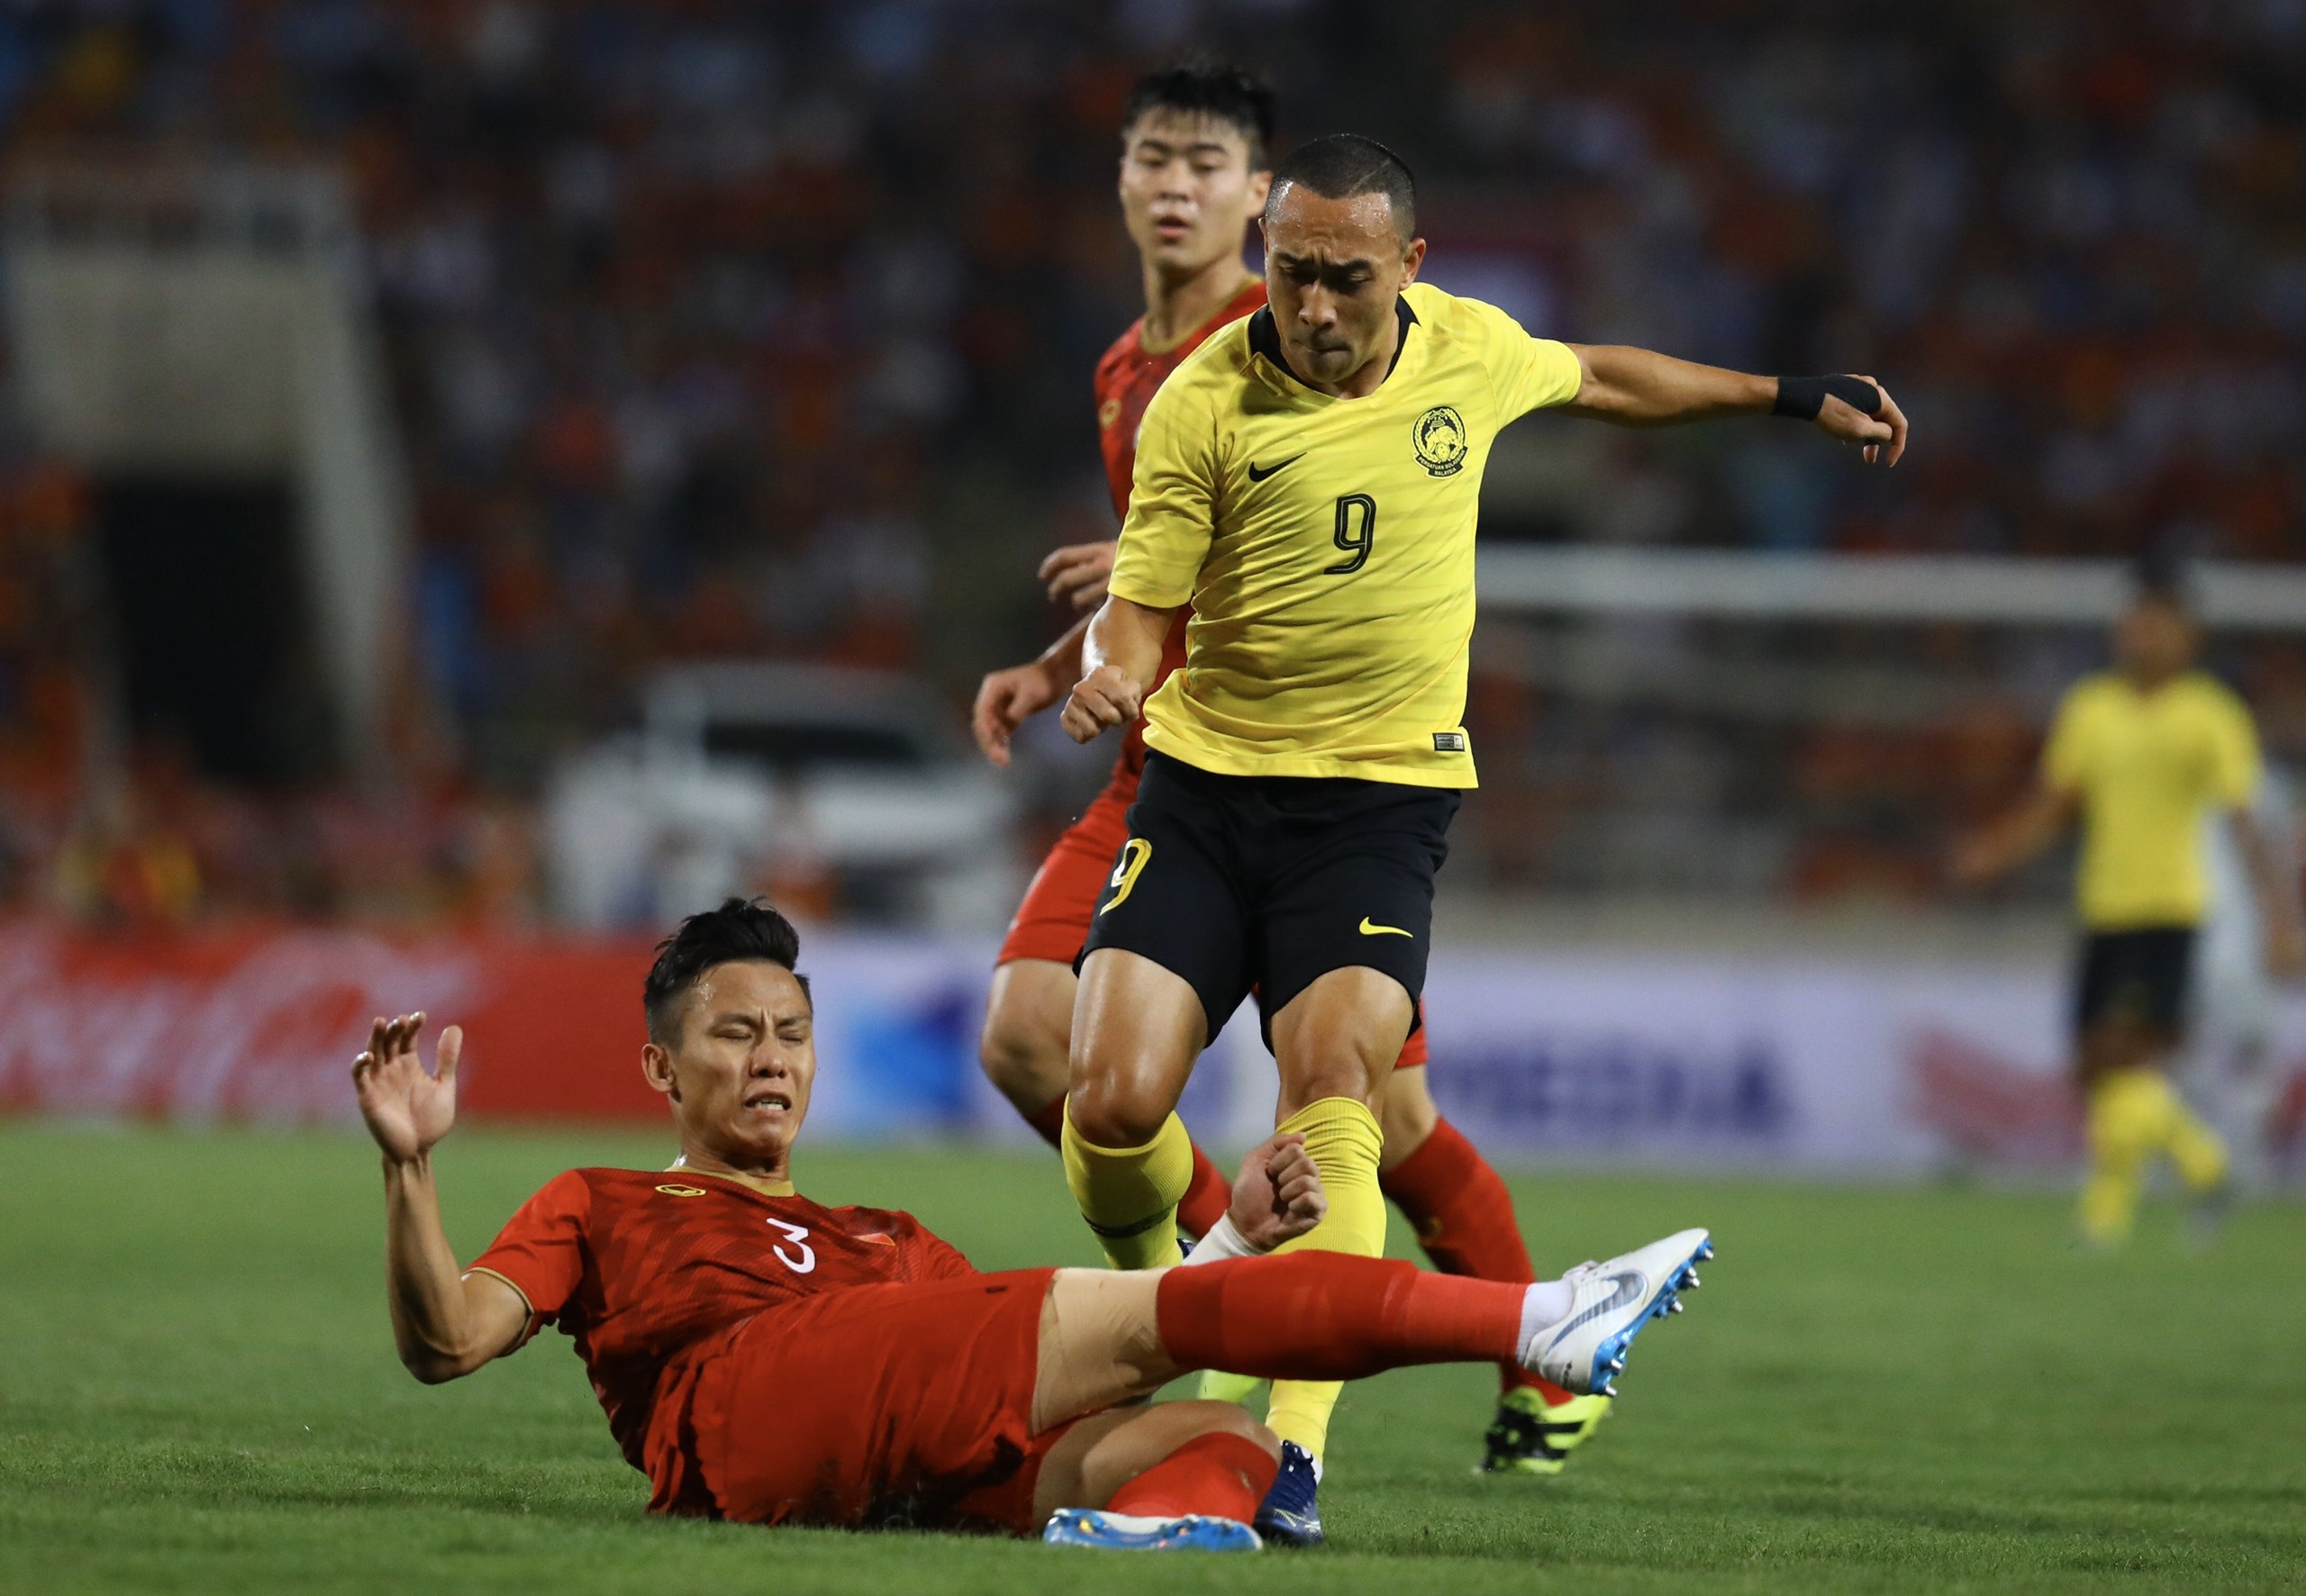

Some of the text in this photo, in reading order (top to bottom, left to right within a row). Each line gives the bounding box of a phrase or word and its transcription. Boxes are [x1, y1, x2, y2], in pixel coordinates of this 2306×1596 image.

[1324, 494, 1376, 575] 9
[1100, 838, 1152, 916] 9
[767, 1218, 815, 1274] 3
